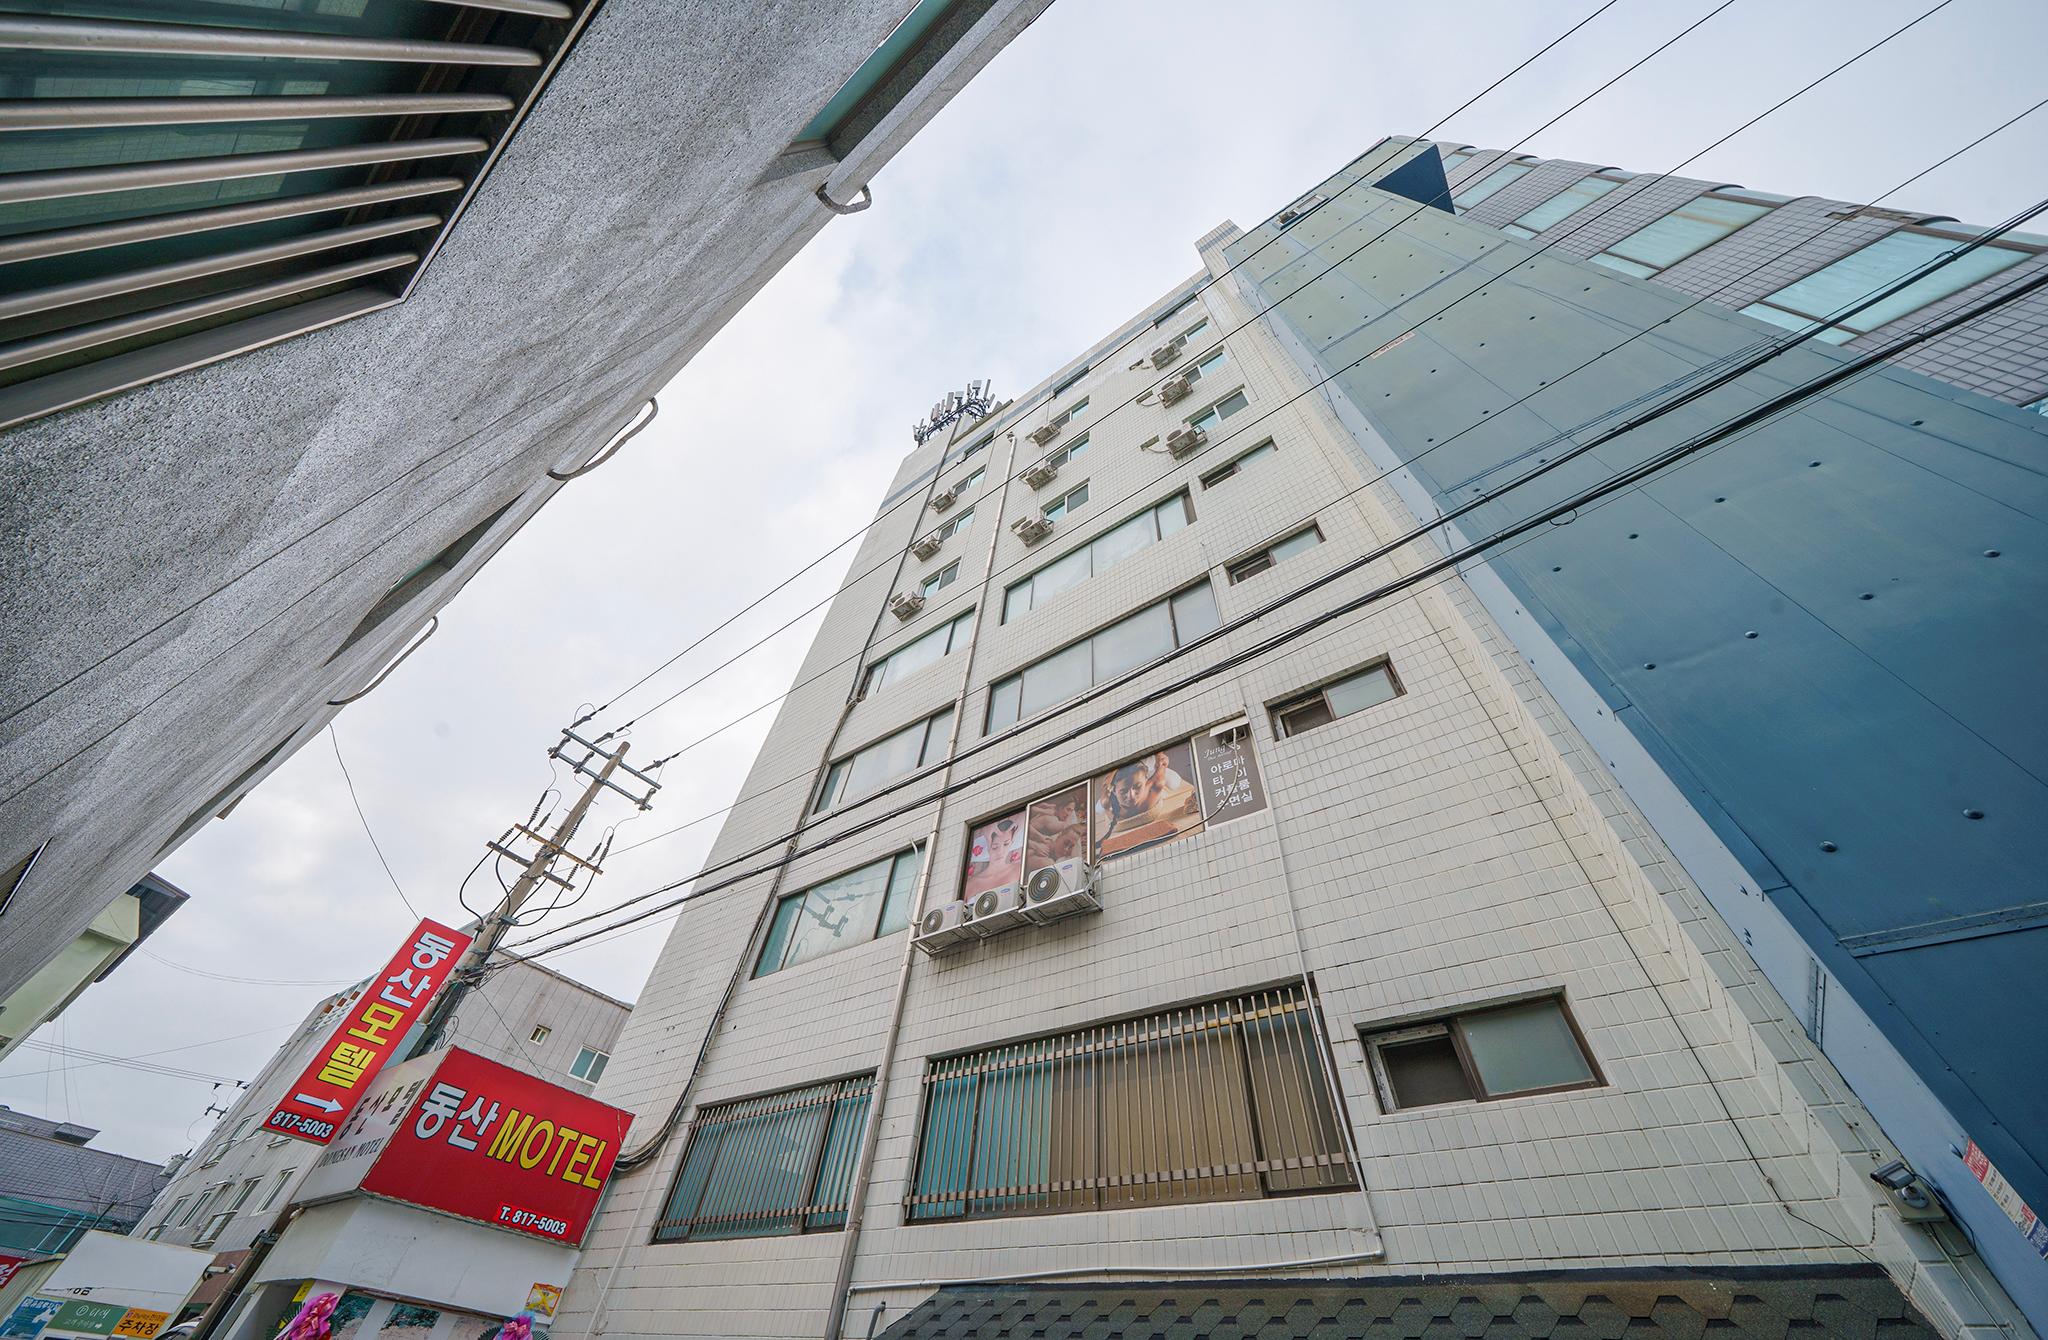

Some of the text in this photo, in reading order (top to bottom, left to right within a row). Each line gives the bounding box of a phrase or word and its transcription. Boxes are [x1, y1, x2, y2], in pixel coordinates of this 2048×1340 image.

[1211, 756, 1245, 773] 아로마
[1217, 790, 1253, 809] 수면실
[317, 931, 456, 1089] 동산모텔
[269, 1110, 334, 1138] 817-5003
[415, 1081, 608, 1190] 동산 MOTEL
[499, 1205, 567, 1235] T. 817-5003
[120, 1320, 159, 1335] 주차장
